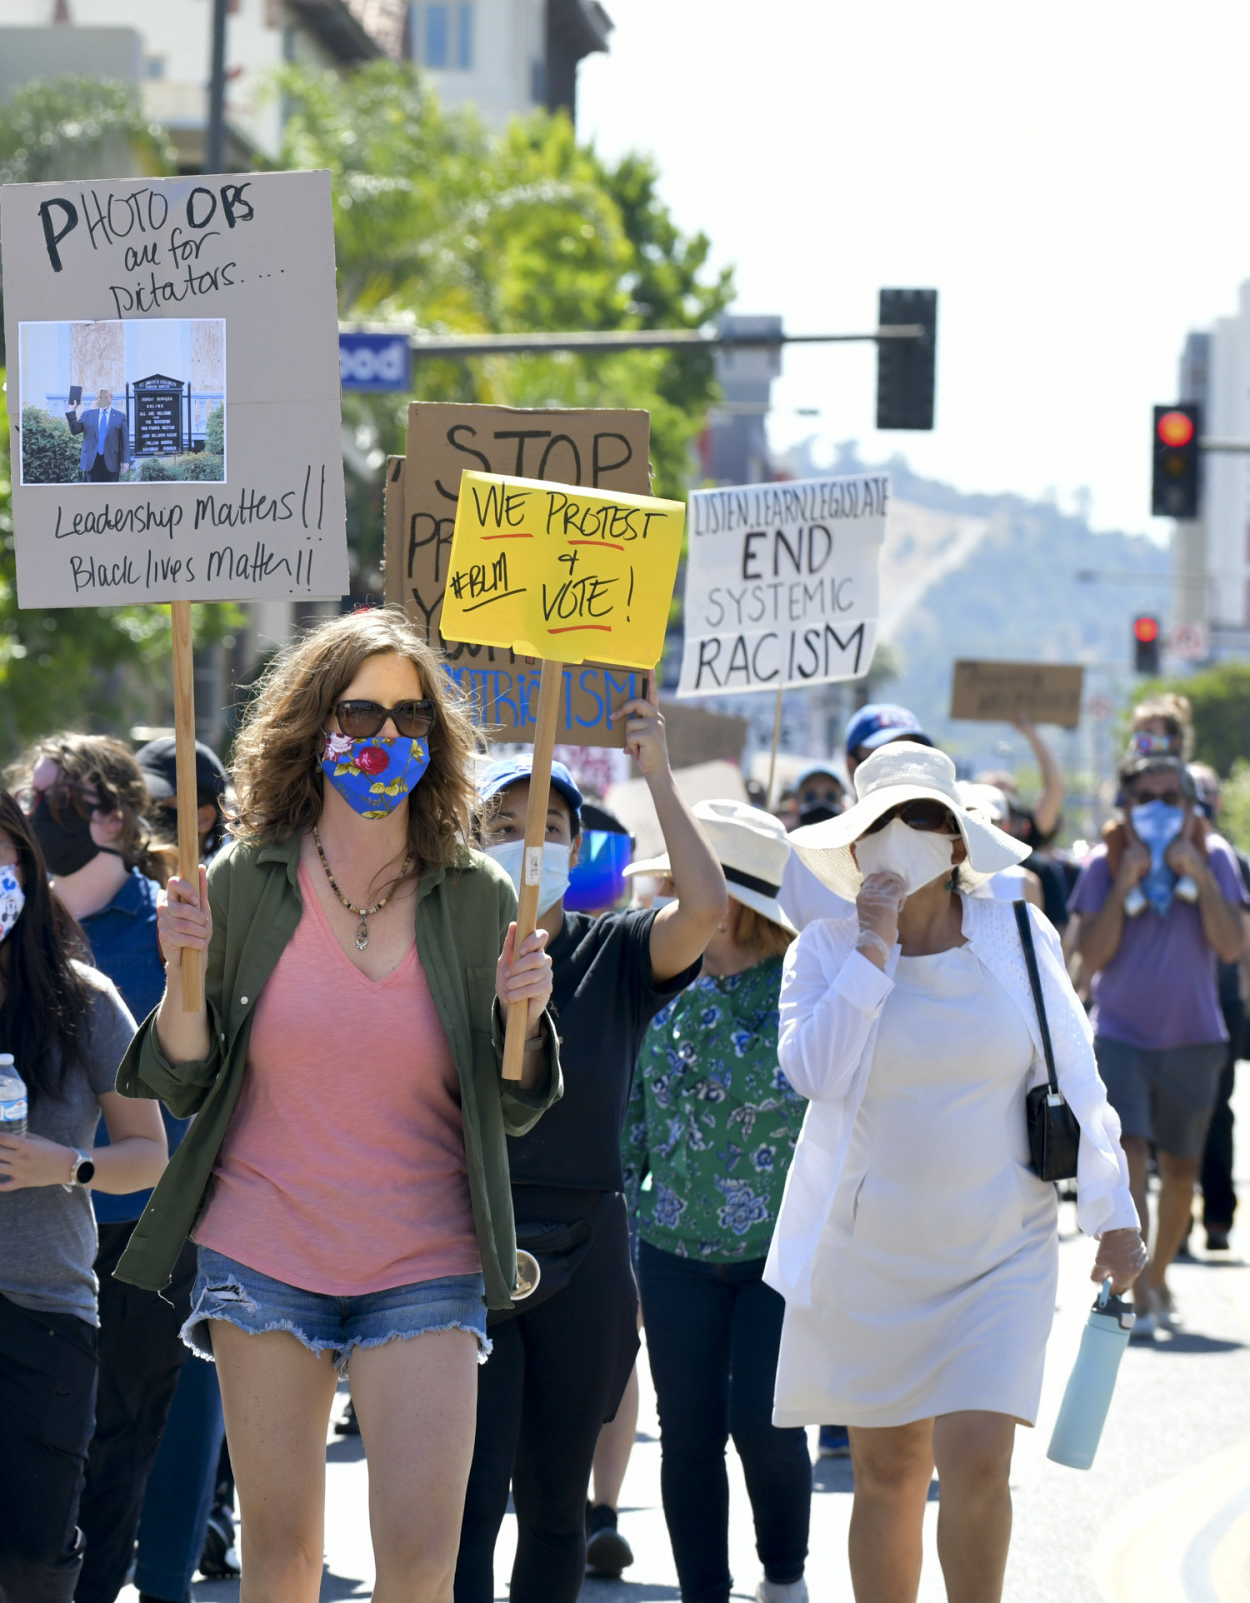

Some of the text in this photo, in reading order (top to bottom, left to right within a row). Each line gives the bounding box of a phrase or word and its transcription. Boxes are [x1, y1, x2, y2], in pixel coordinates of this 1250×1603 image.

[38, 188, 168, 272] PHOTO
[124, 227, 221, 272] are for
[434, 424, 632, 501] STOP
[54, 501, 183, 539] Leadership
[472, 481, 668, 541] WE PROTEST
[70, 555, 140, 592] Black
[450, 552, 510, 600] #BLM
[742, 524, 833, 581] END
[705, 577, 854, 627] SYSTEMIC
[695, 622, 865, 689] RACISM
